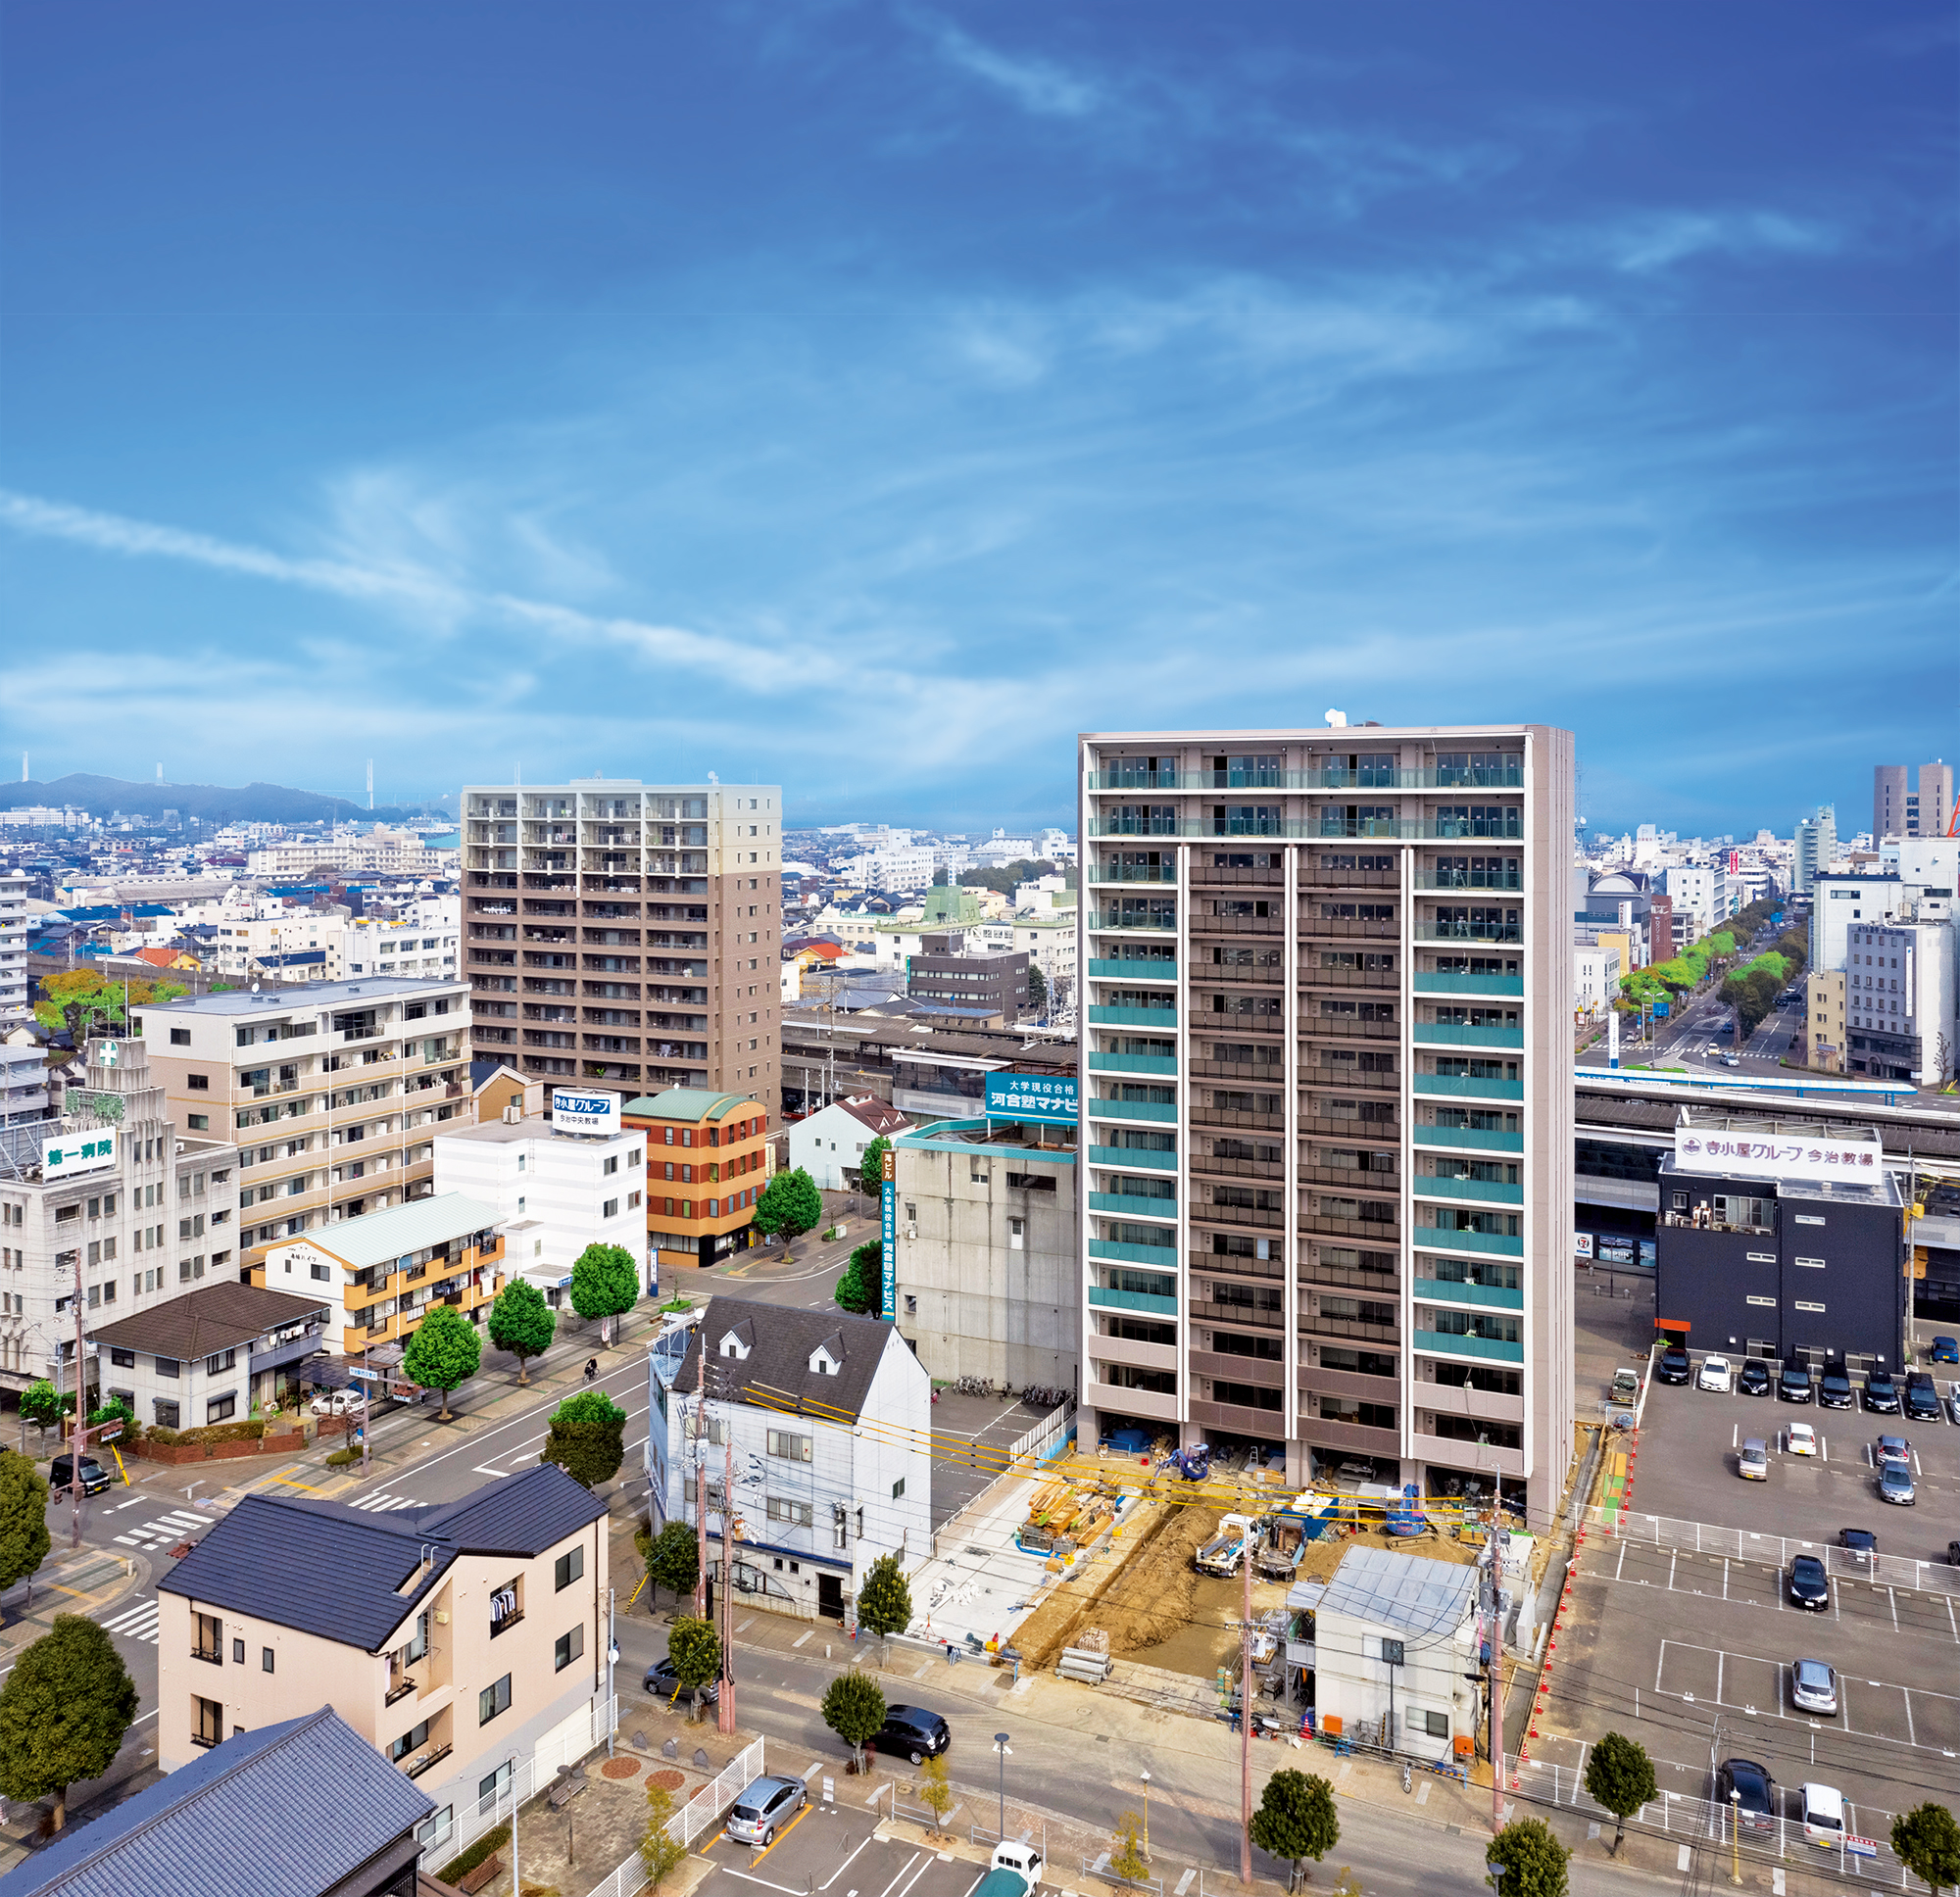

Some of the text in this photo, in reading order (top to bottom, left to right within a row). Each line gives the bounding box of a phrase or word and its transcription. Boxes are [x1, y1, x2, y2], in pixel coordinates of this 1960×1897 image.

[1009, 1081, 1074, 1095] 大学現役合格
[555, 1096, 610, 1113] 寺小屋グループ
[560, 1114, 599, 1125] 今治中央教場
[47, 1139, 113, 1167] 第一病院
[1705, 1141, 1874, 1166] 寺小屋グループ 今治教場
